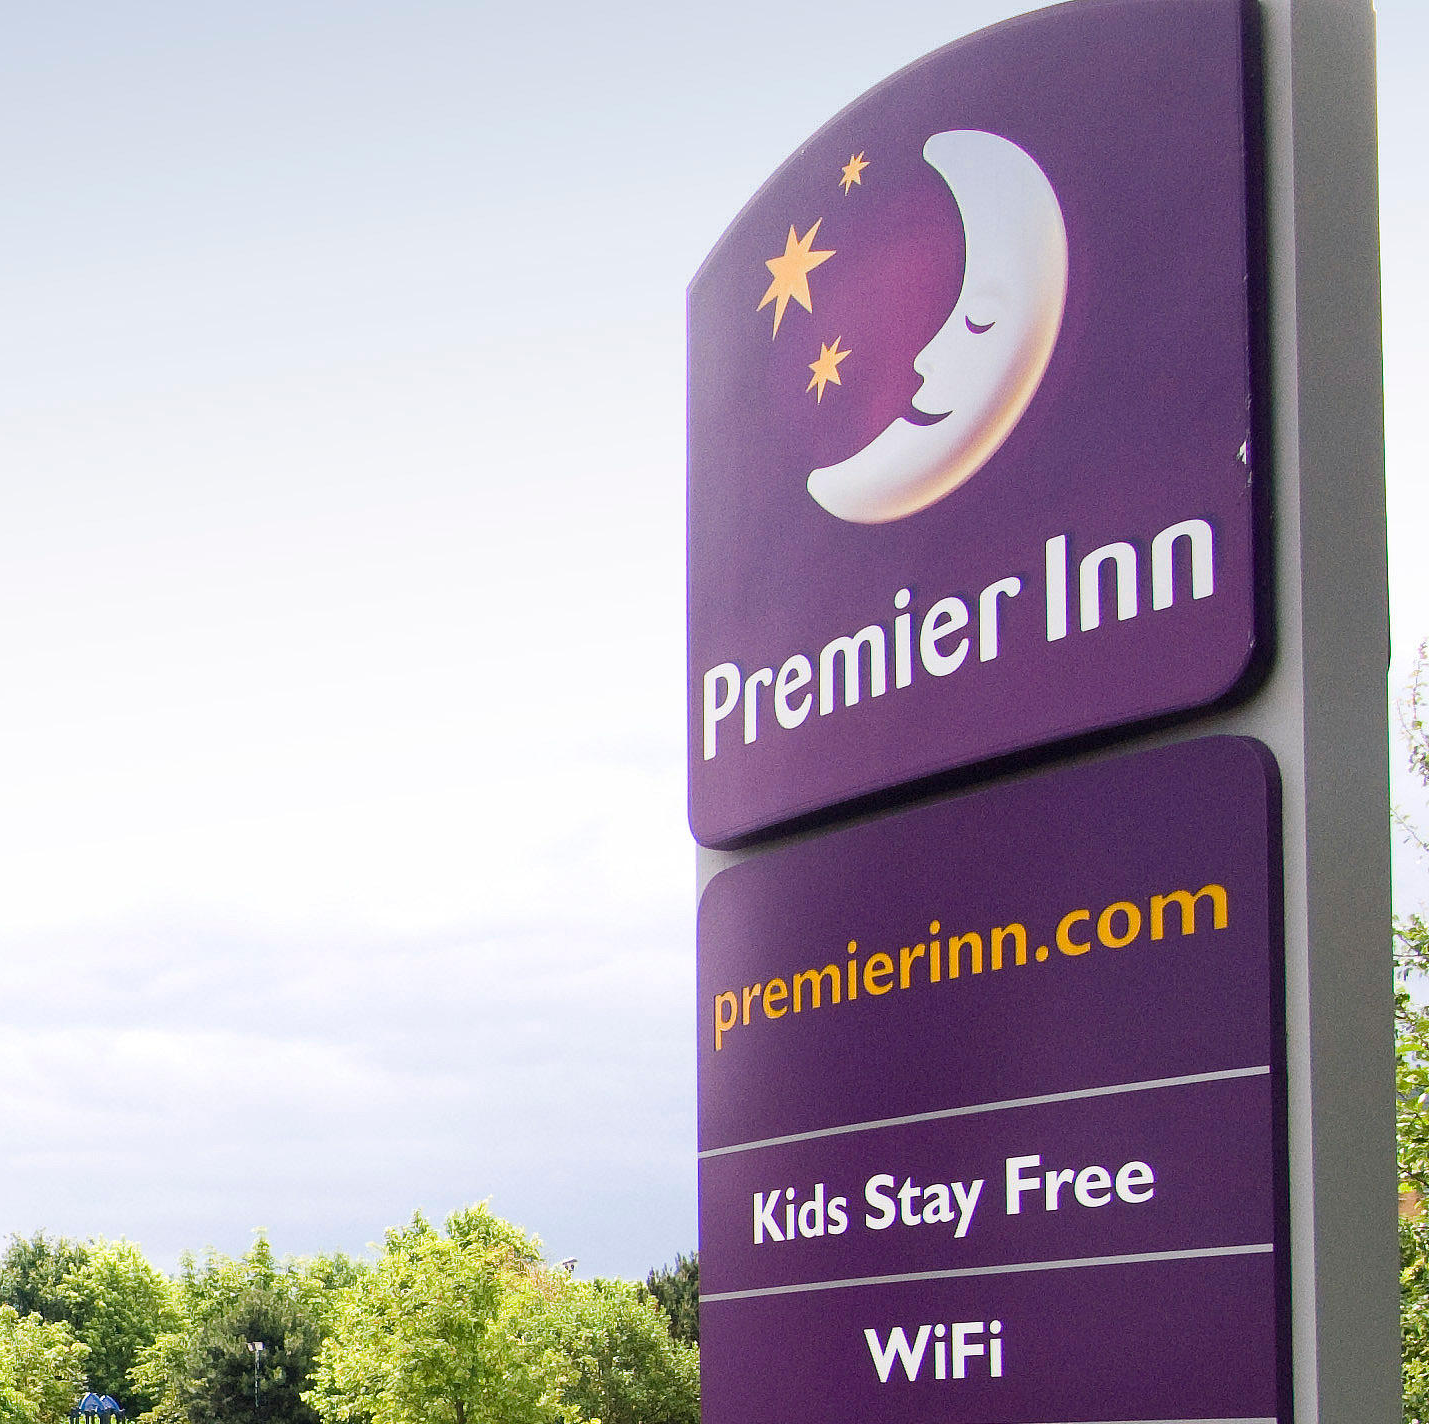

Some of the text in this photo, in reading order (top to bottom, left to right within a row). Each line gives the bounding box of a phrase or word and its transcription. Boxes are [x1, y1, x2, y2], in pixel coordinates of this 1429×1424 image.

[703, 518, 1215, 761] Premier Inn
[714, 883, 1230, 1051] premierinn.com
[752, 1154, 1155, 1245] Kids Stay Free
[864, 1319, 1003, 1384] WiFi
